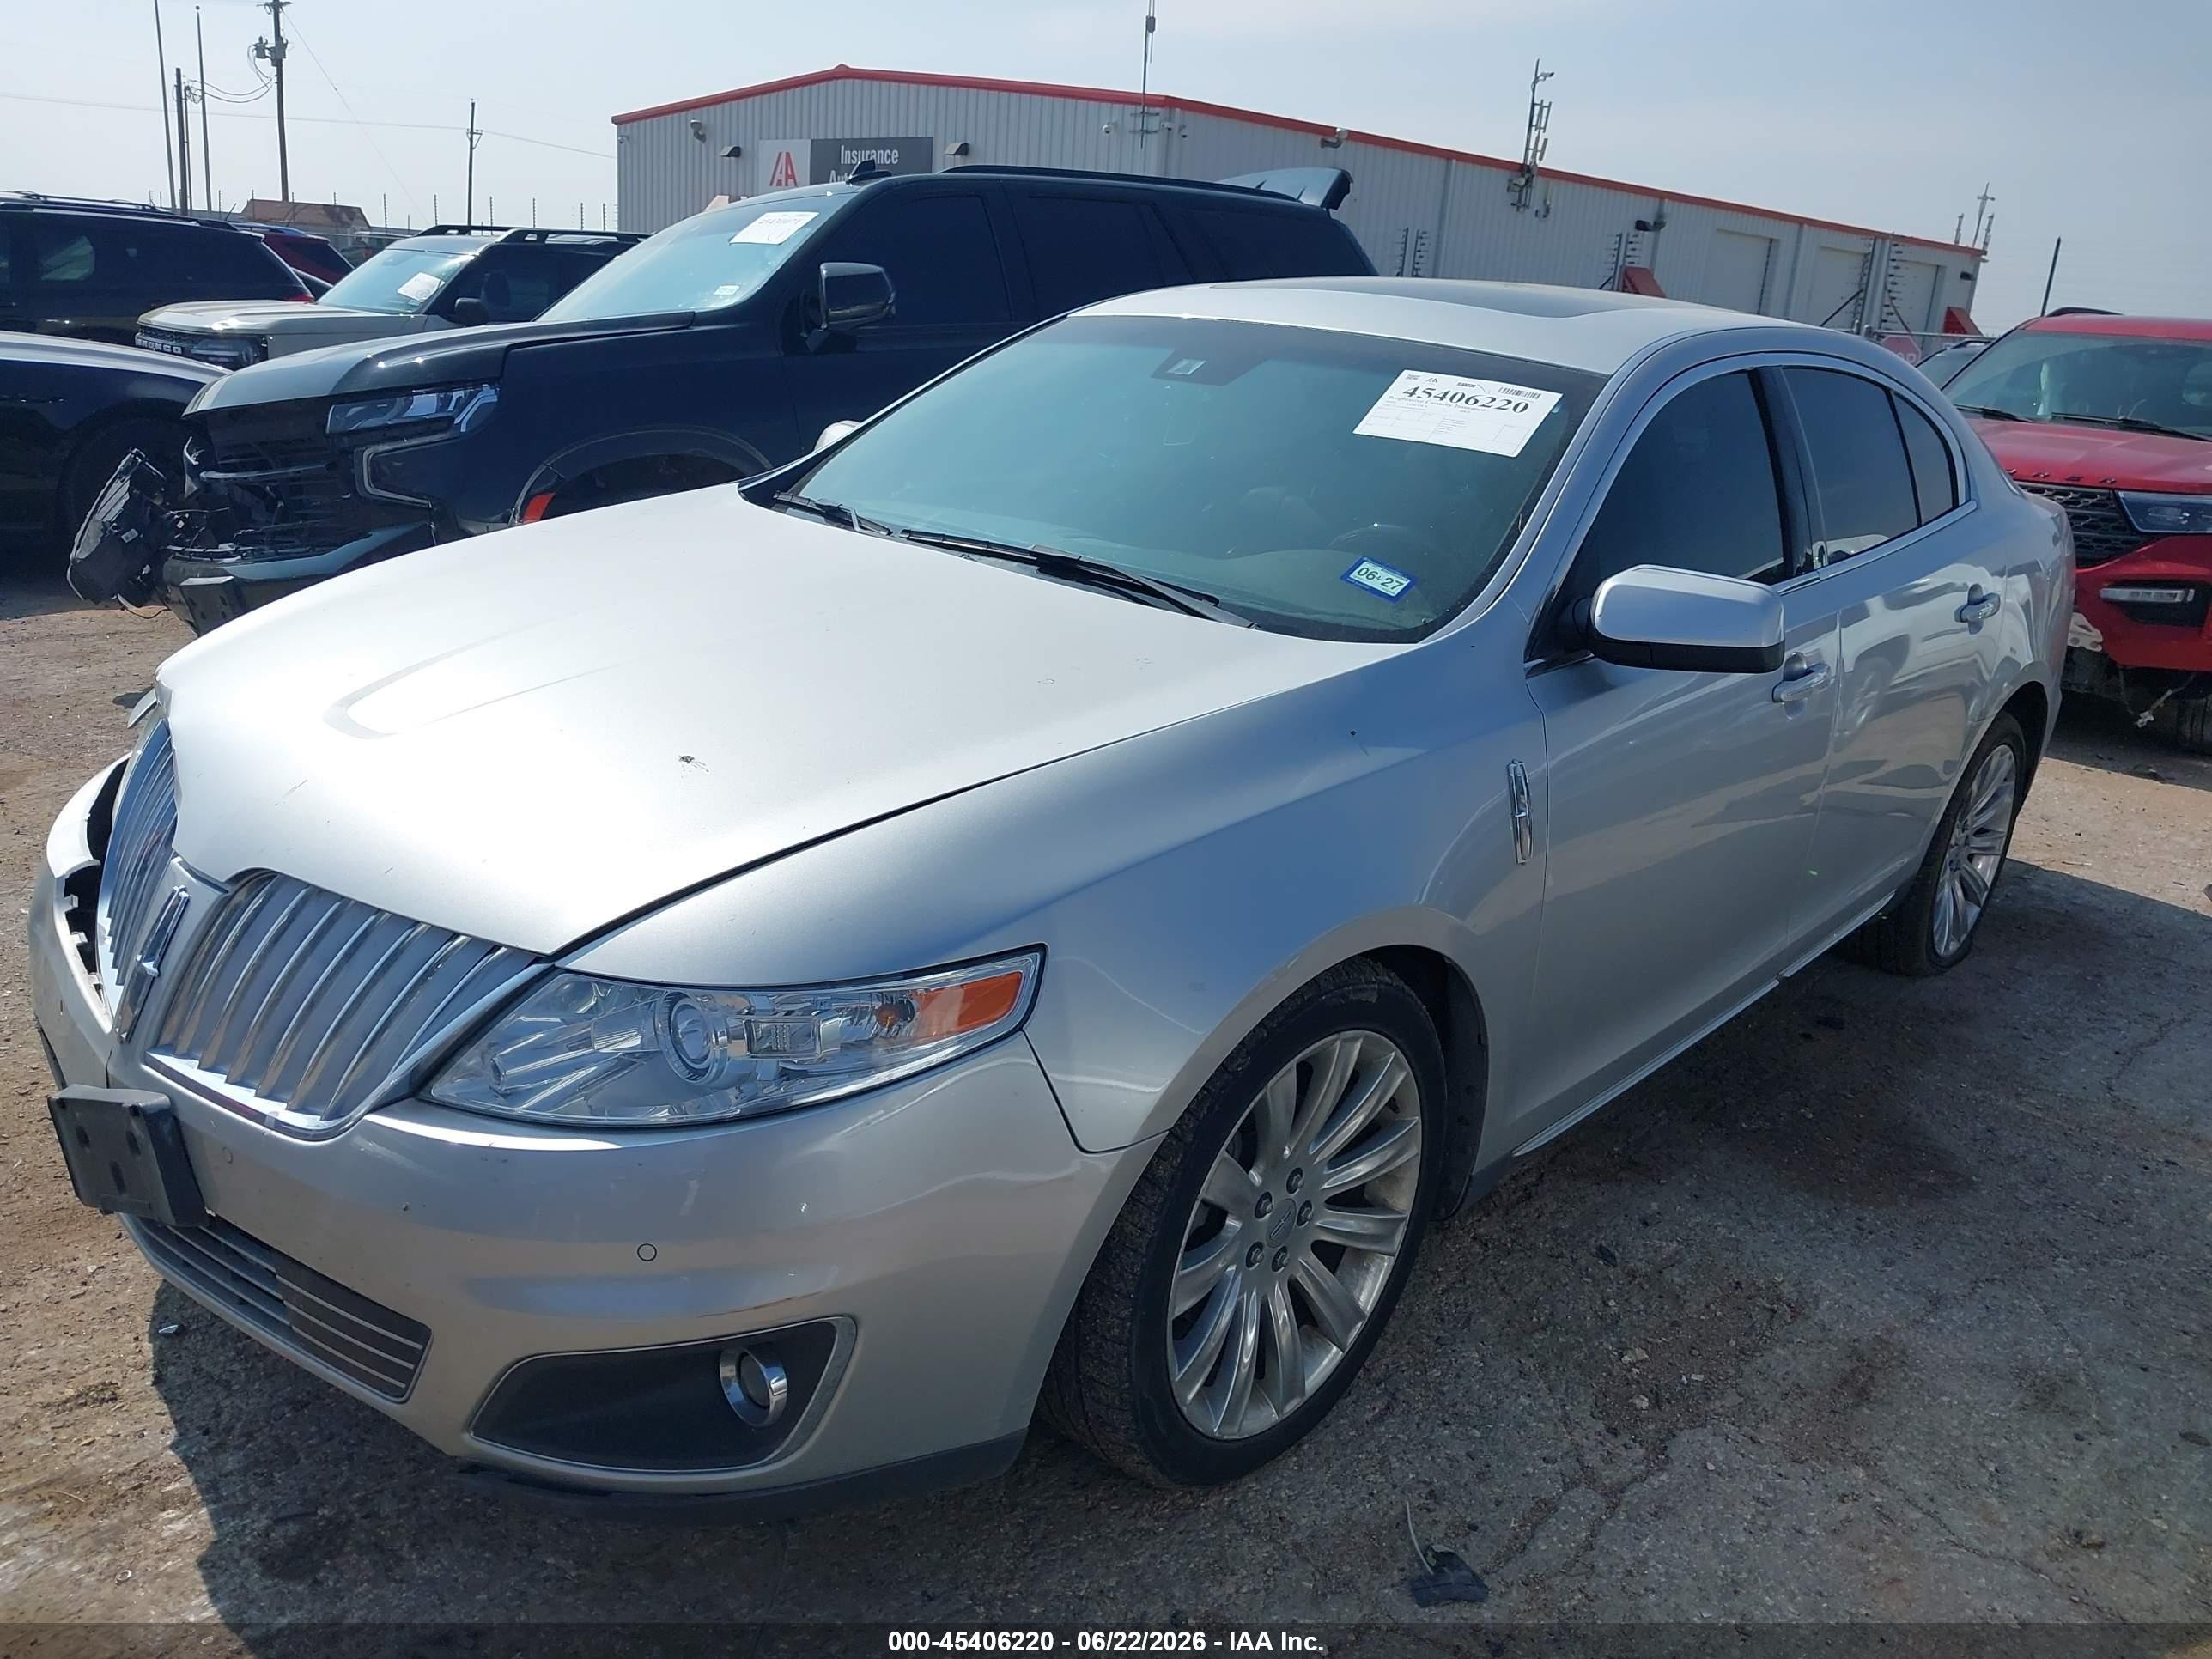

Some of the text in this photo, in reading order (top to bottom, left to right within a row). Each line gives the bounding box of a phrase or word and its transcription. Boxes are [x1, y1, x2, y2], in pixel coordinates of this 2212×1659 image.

[840, 144, 900, 165] Insurance
[137, 337, 182, 354] BRONCO
[1402, 385, 1530, 415] 45406220
